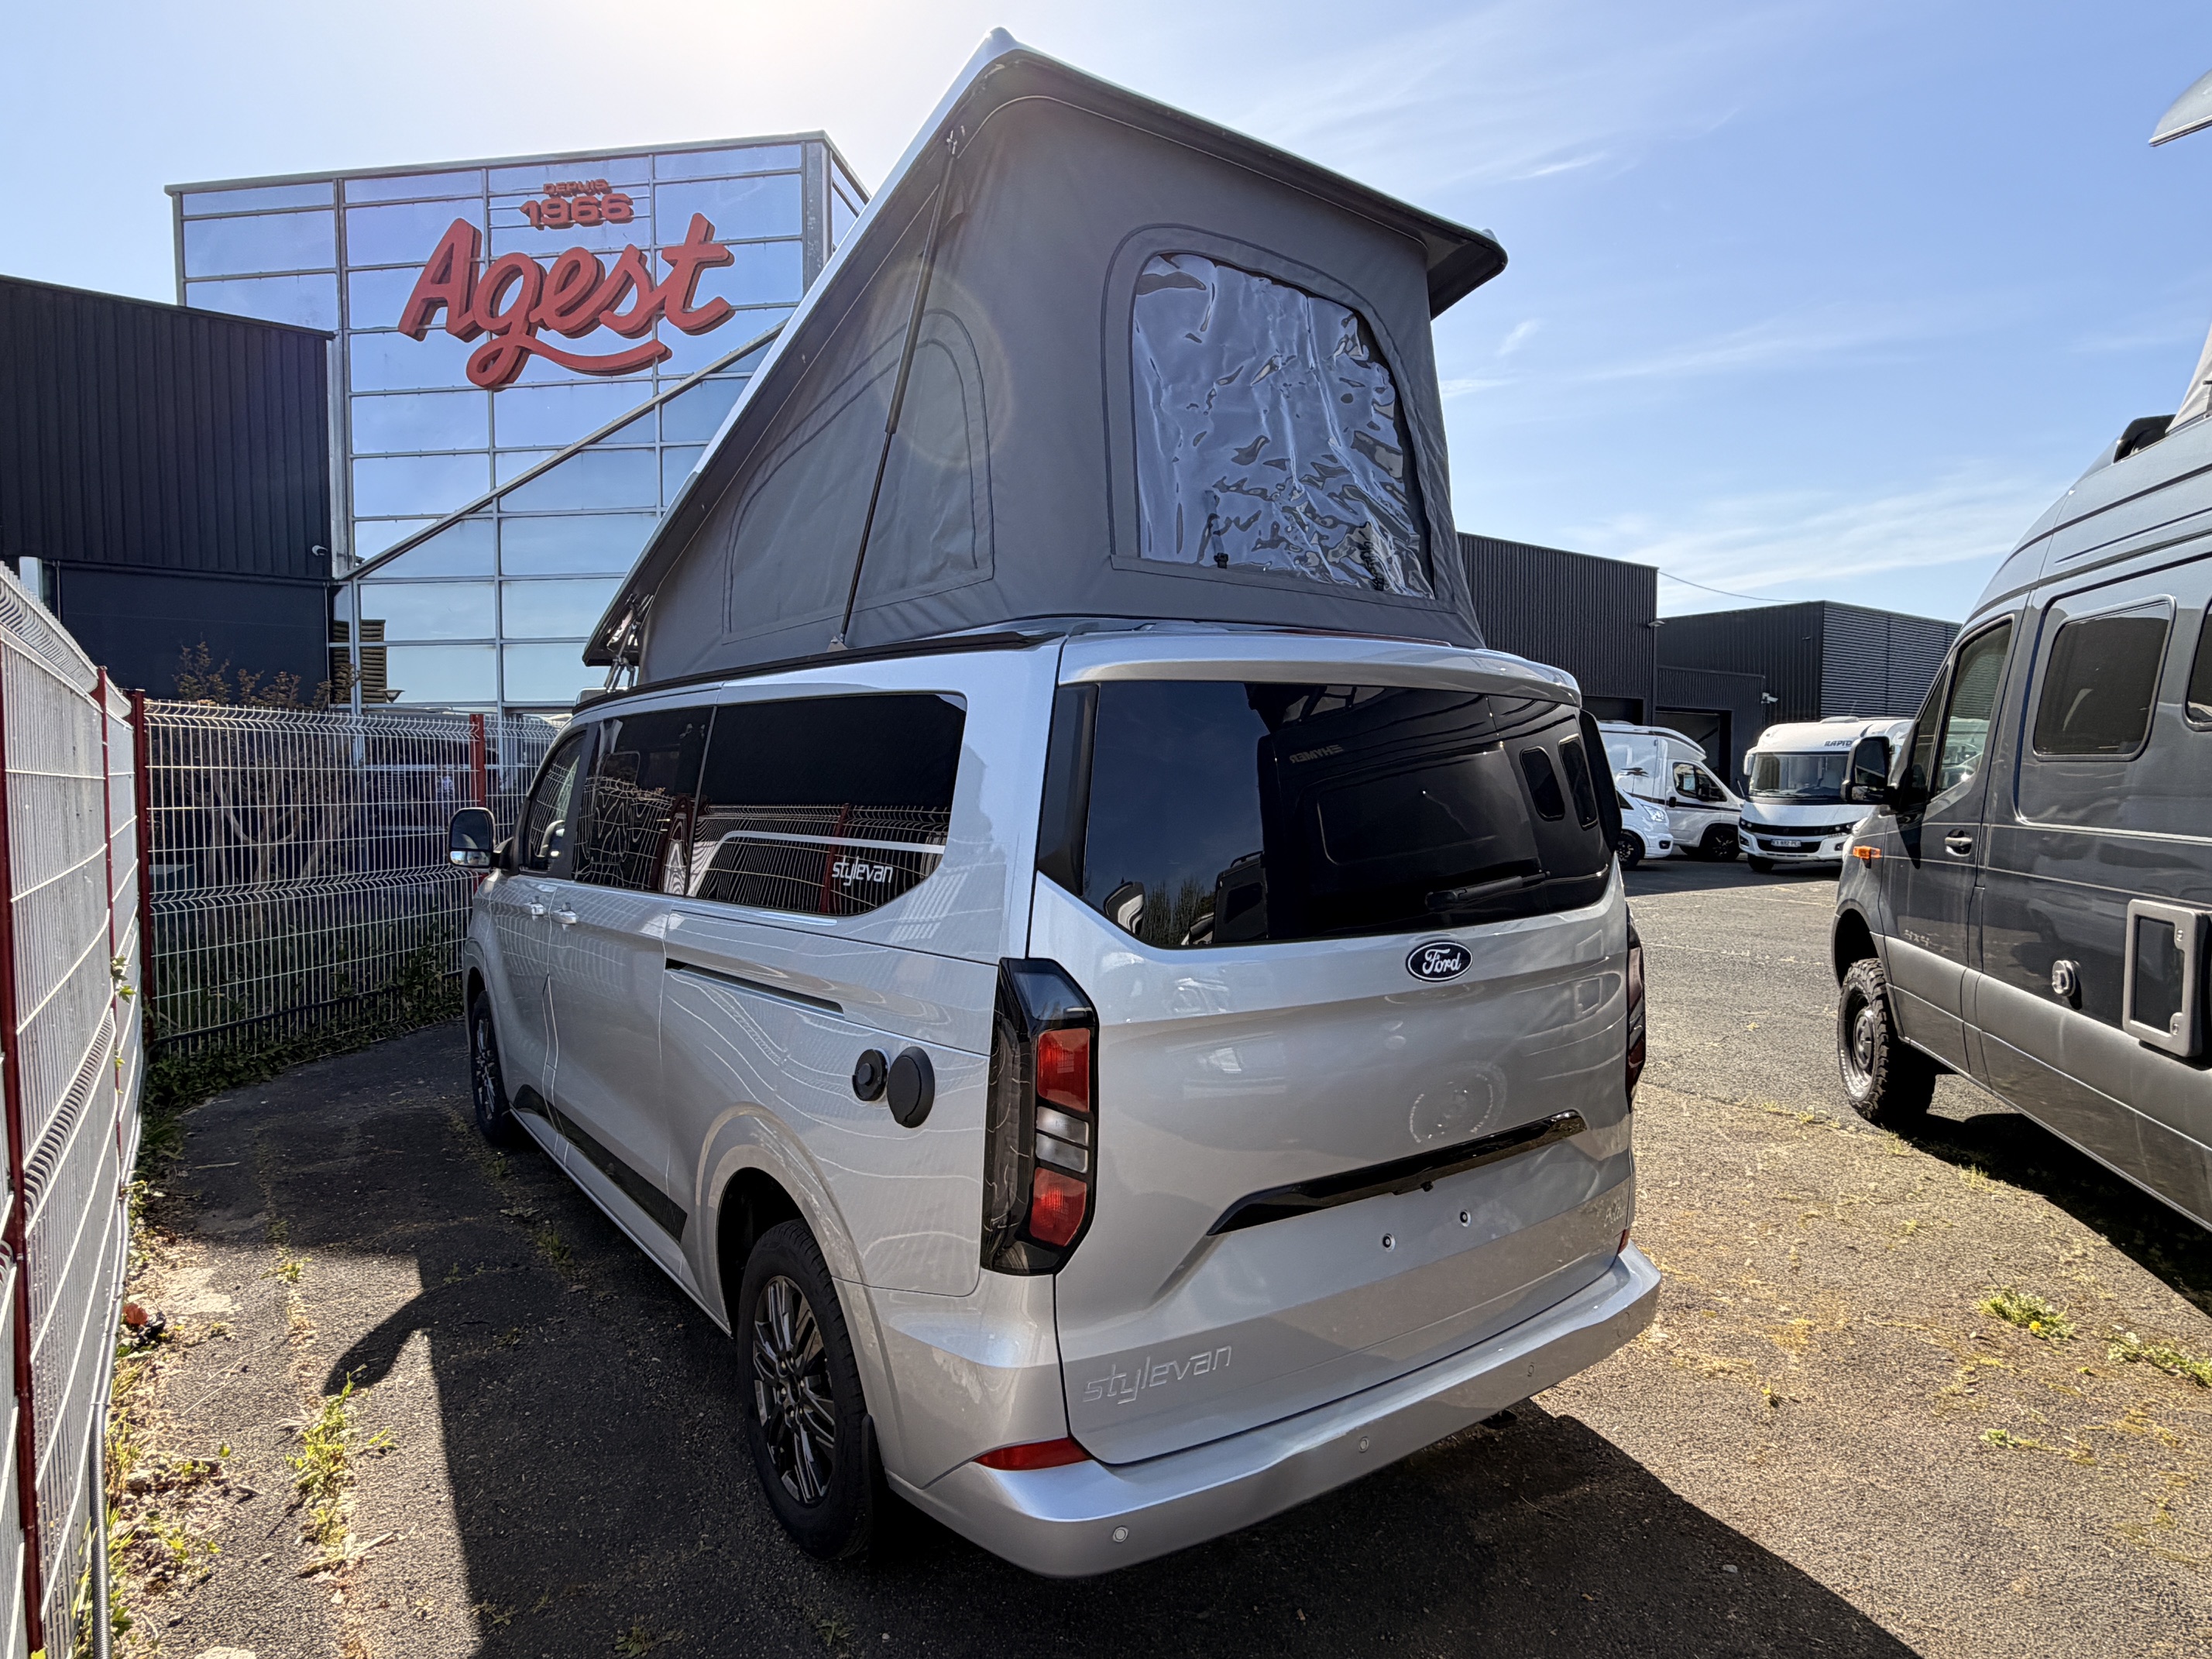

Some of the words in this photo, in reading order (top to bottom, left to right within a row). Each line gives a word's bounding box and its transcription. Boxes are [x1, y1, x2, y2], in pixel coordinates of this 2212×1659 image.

[543, 179, 612, 197] DEPUIS
[519, 193, 634, 230] 1966
[398, 212, 735, 391] Agest
[831, 854, 893, 886] stylevan
[1422, 948, 1462, 974] Ford
[1083, 1345, 1231, 1404] stylevan
